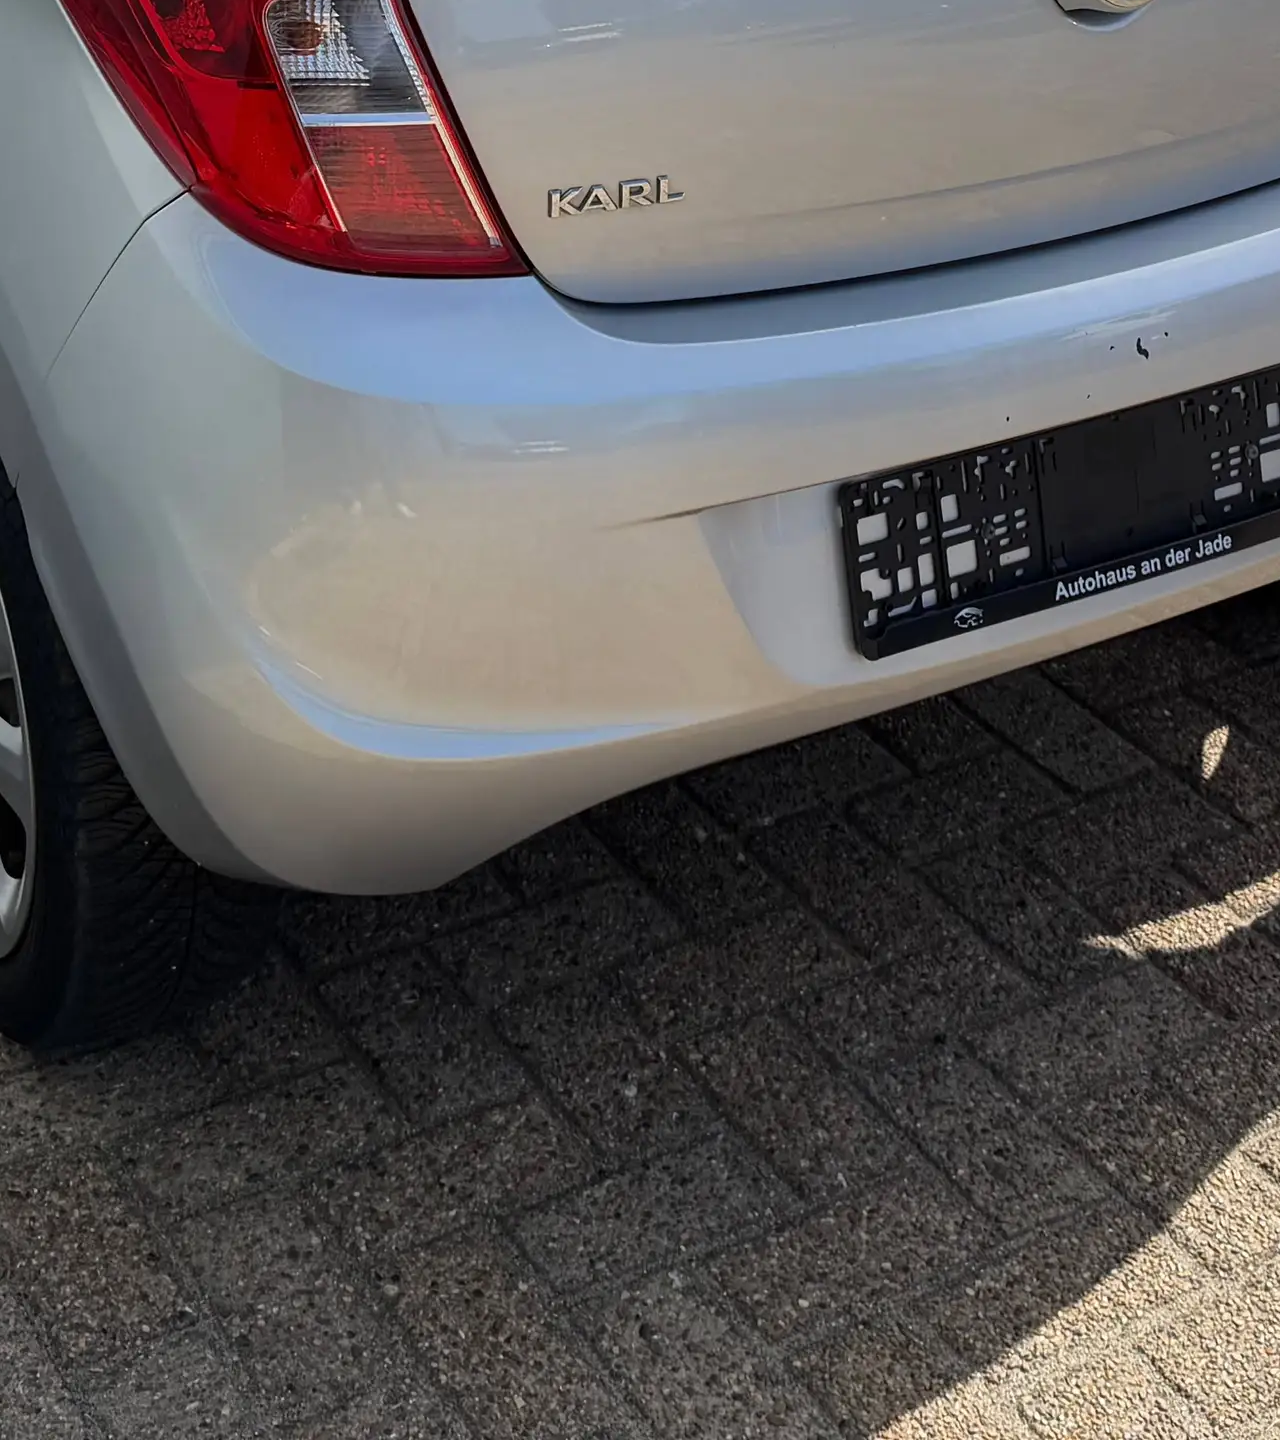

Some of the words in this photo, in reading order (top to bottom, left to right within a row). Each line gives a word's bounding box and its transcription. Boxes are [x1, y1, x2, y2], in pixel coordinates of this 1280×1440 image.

[547, 174, 686, 219] KARL
[1055, 565, 1137, 602] Autohaus
[1140, 556, 1162, 575] an
[1165, 546, 1192, 567] der
[1195, 533, 1233, 559] Jade
